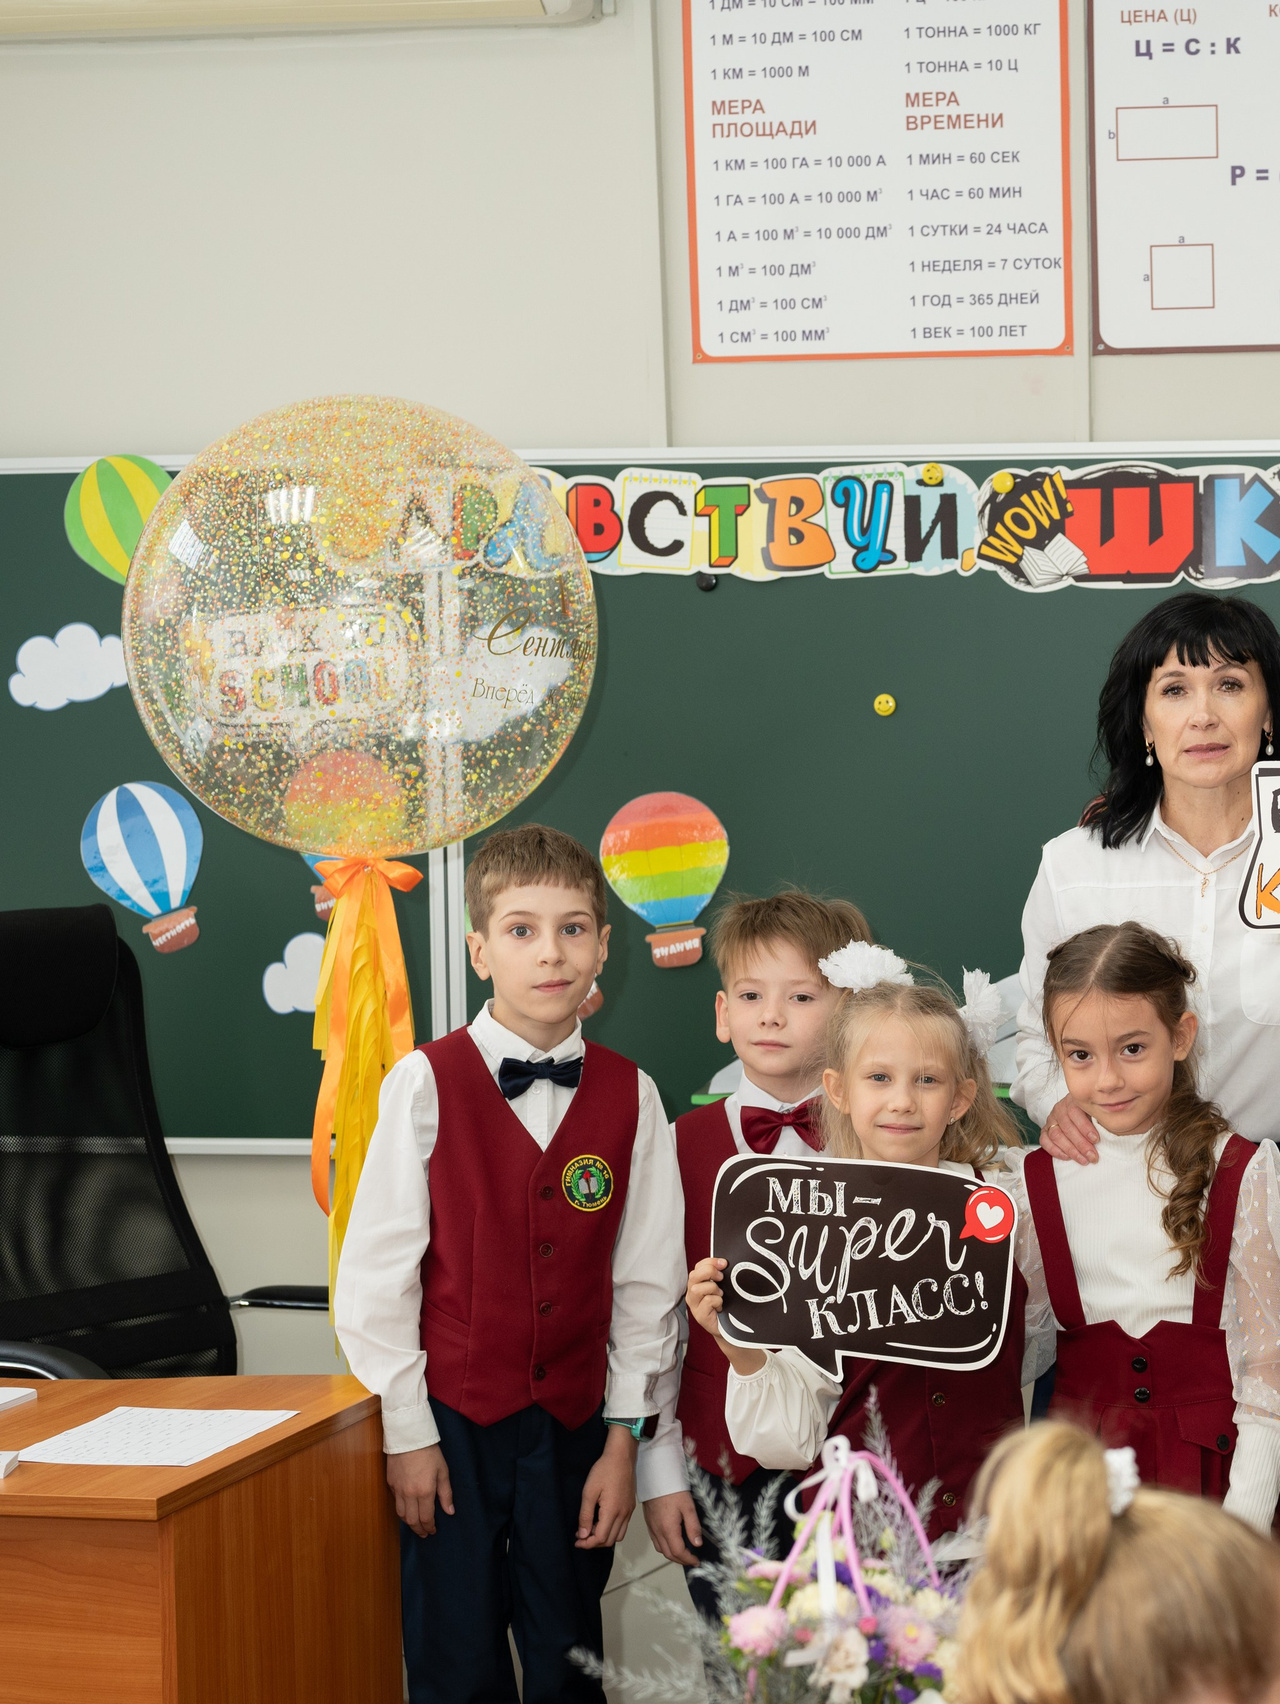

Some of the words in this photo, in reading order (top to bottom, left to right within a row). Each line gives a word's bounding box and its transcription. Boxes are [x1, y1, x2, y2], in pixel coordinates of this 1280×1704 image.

[1120, 8, 1169, 26] ЦЕНА
[722, 33, 734, 46] М
[751, 32, 767, 45] 10
[770, 30, 794, 46] ДМ
[811, 29, 836, 43] 100
[840, 28, 863, 42] СМ
[915, 25, 969, 39] ТОННА
[986, 23, 1020, 37] 1000
[1023, 22, 1042, 36] КГ
[722, 67, 744, 80] КМ
[761, 65, 794, 79] 1000
[798, 64, 810, 78] М
[916, 60, 970, 74] ТОННА
[986, 58, 1004, 72] 10
[711, 98, 766, 116] МЕРА
[905, 90, 960, 108] МЕРА
[712, 119, 817, 140] ПЛОЩАДИ
[905, 112, 1004, 132] ВРЕМЕНИ
[724, 158, 746, 172] КМ
[763, 156, 788, 170] 100
[791, 156, 810, 169] ГА
[826, 155, 843, 168] 10
[846, 154, 872, 168] 000
[875, 154, 887, 167] А
[918, 152, 952, 166] МИН
[969, 151, 986, 164] 60
[990, 150, 1020, 164] СЕК
[726, 194, 744, 207] ГА
[760, 192, 786, 206] 100
[788, 192, 800, 205] А
[817, 191, 833, 204] 10
[836, 190, 862, 204] 000
[919, 187, 950, 201] ЧАС
[968, 186, 985, 200] 60
[988, 186, 1022, 199] МИН
[726, 230, 738, 242] А
[754, 228, 779, 242] 100
[816, 226, 832, 240] 10
[836, 226, 862, 240] 000
[920, 223, 969, 238] СУТКИ
[986, 222, 1003, 236] 24
[1006, 221, 1049, 235] ЧАСА
[921, 258, 983, 274] НЕДЕЛЯ
[1000, 258, 1008, 271] 7
[1012, 256, 1063, 271] СУТОК
[922, 294, 952, 309] ГОД
[969, 293, 994, 306] 365
[997, 289, 1040, 308] ДНЕЙ
[922, 326, 952, 339] ВЕК
[969, 325, 994, 338] 100
[998, 324, 1028, 338] ЛЕТ
[980, 470, 1074, 564] WOW!
[471, 677, 535, 709] Вперёд
[730, 1208, 968, 1314] Super
[805, 1270, 989, 1339] КЛАСС!
